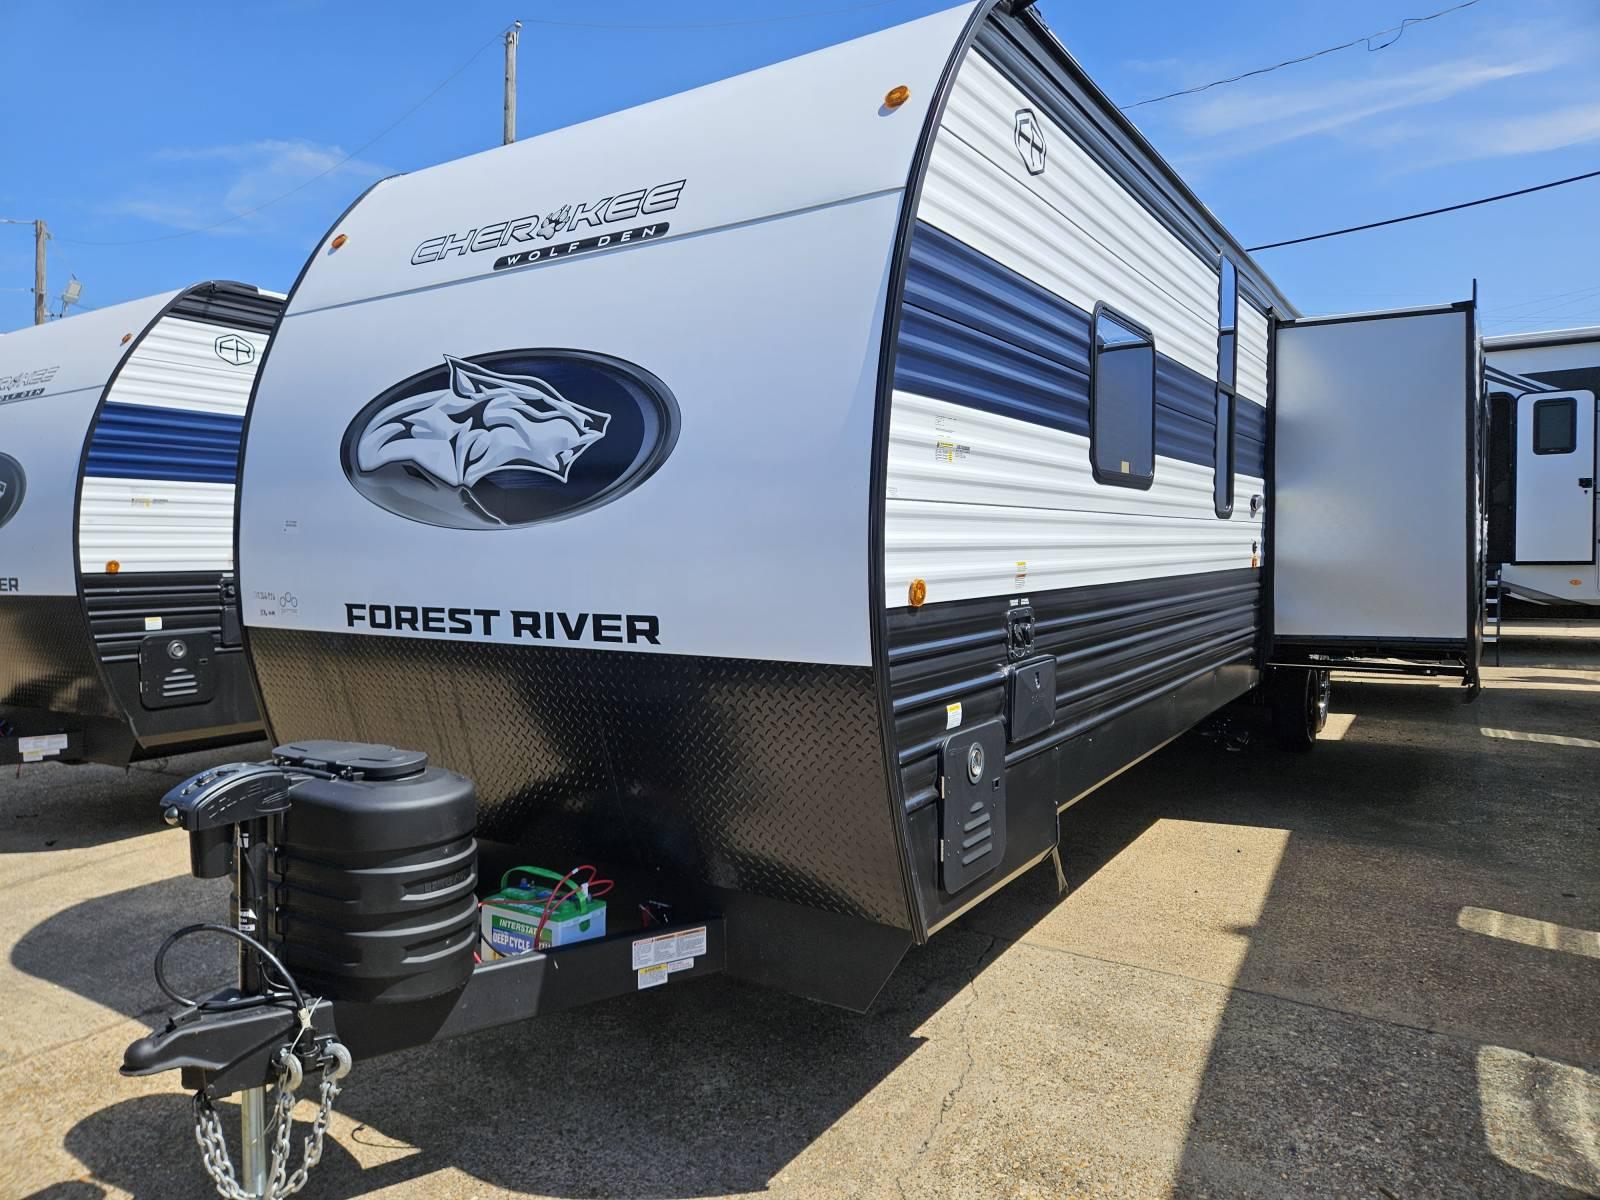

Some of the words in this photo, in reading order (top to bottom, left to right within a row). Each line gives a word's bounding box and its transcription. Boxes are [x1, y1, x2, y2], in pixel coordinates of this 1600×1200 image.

[410, 178, 687, 266] CHEROKEE
[506, 243, 580, 266] WOLF
[597, 225, 658, 248] DEN
[344, 602, 501, 636] FOREST
[510, 610, 662, 646] RIVER
[493, 932, 509, 945] DEEP
[509, 935, 531, 951] CYCLE
[499, 919, 542, 937] INTERSTAT
